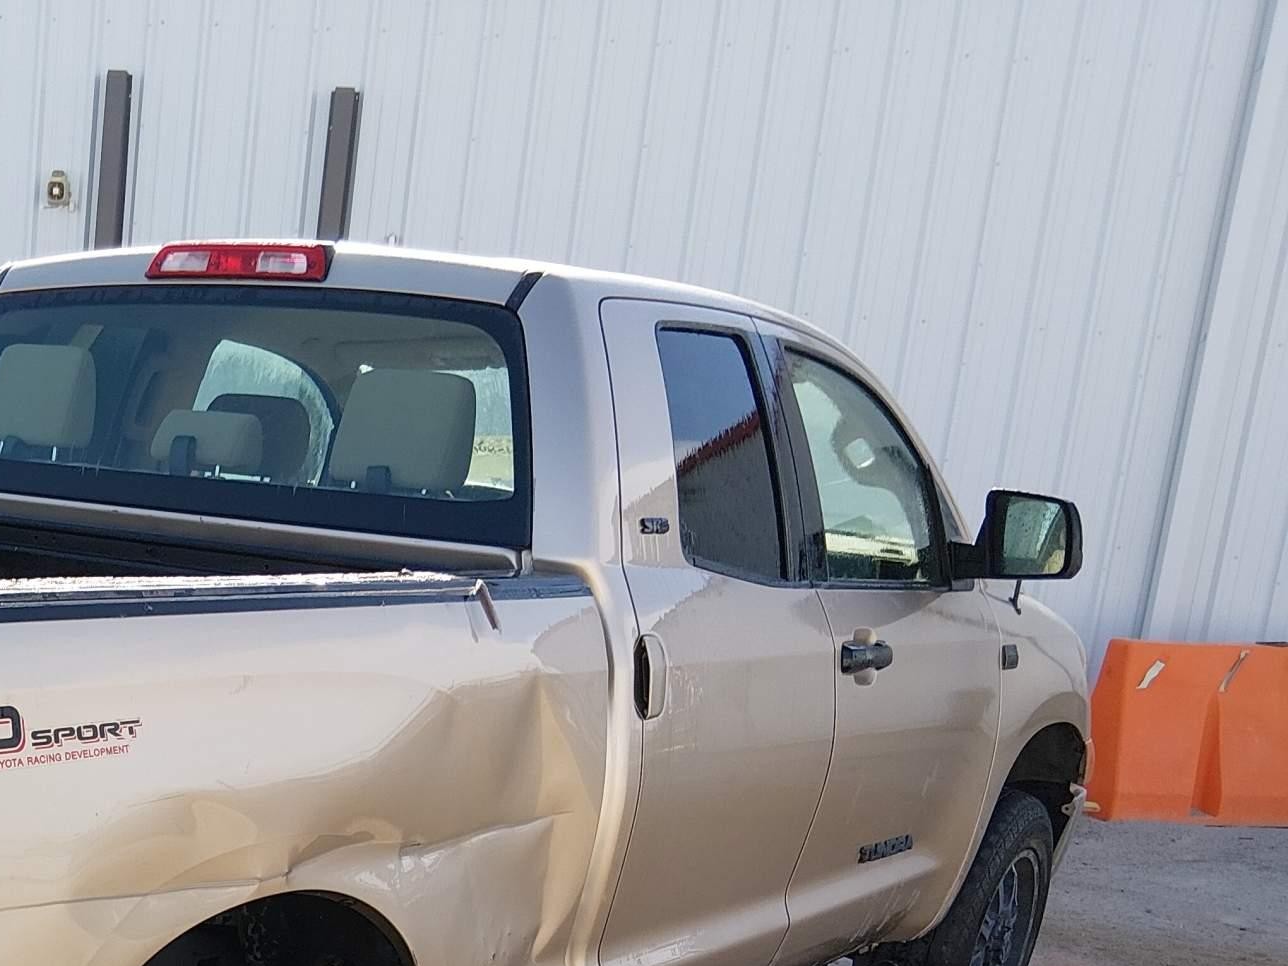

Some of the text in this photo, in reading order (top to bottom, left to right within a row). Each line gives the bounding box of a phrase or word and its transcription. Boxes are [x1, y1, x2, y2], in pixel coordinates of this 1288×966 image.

[31, 718, 142, 748] SPORT
[27, 753, 62, 767] RACING
[64, 744, 130, 762] DEVELOPMENT
